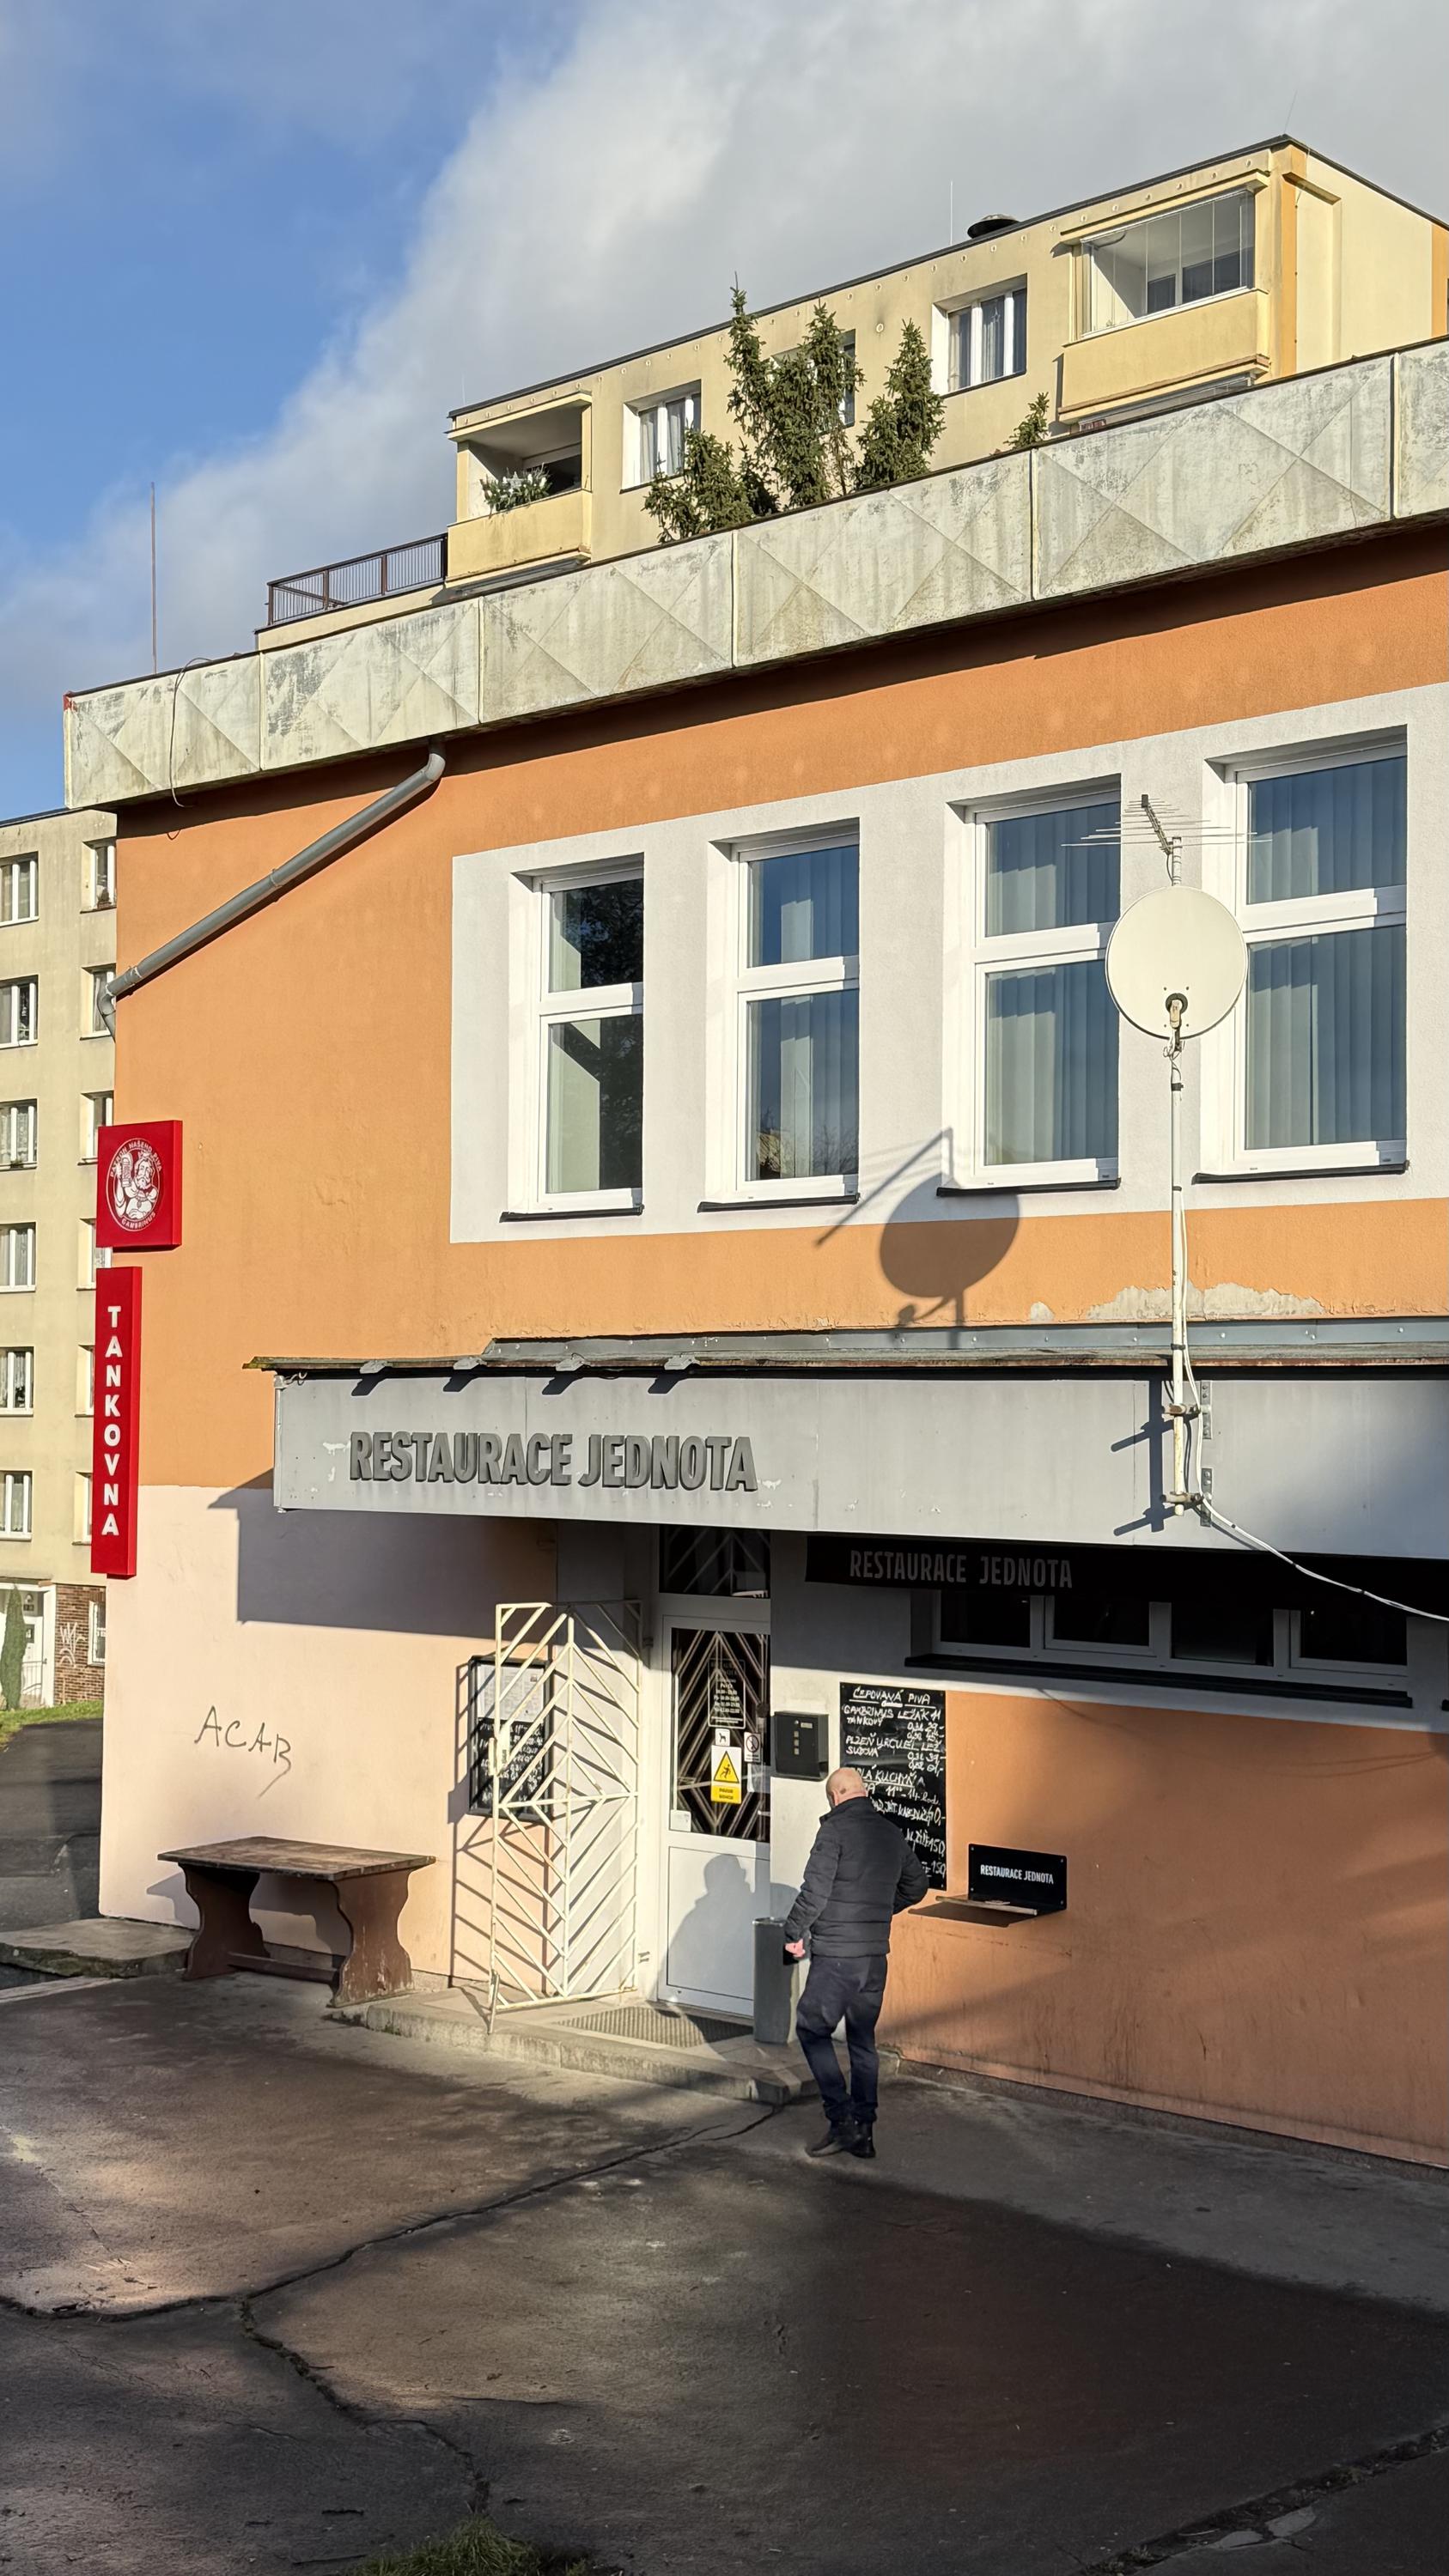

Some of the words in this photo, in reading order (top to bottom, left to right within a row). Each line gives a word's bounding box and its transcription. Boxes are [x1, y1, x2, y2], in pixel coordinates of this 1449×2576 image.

[152, 1151, 162, 1172] PIVA
[121, 1212, 156, 1230] GAMBRINUS
[101, 1305, 123, 1536] TANKOVNA
[350, 1431, 573, 1485] RESTAURACE
[578, 1434, 758, 1492] JEDNOTA
[849, 1549, 967, 1583] RESTAURACE
[979, 1555, 1073, 1589] JEDNOTA
[908, 1692, 931, 1705] PIVA
[194, 1705, 291, 1799] ACAB
[980, 1864, 1022, 1880] RESTAURACE
[1023, 1870, 1054, 1885] JEDNOTA
